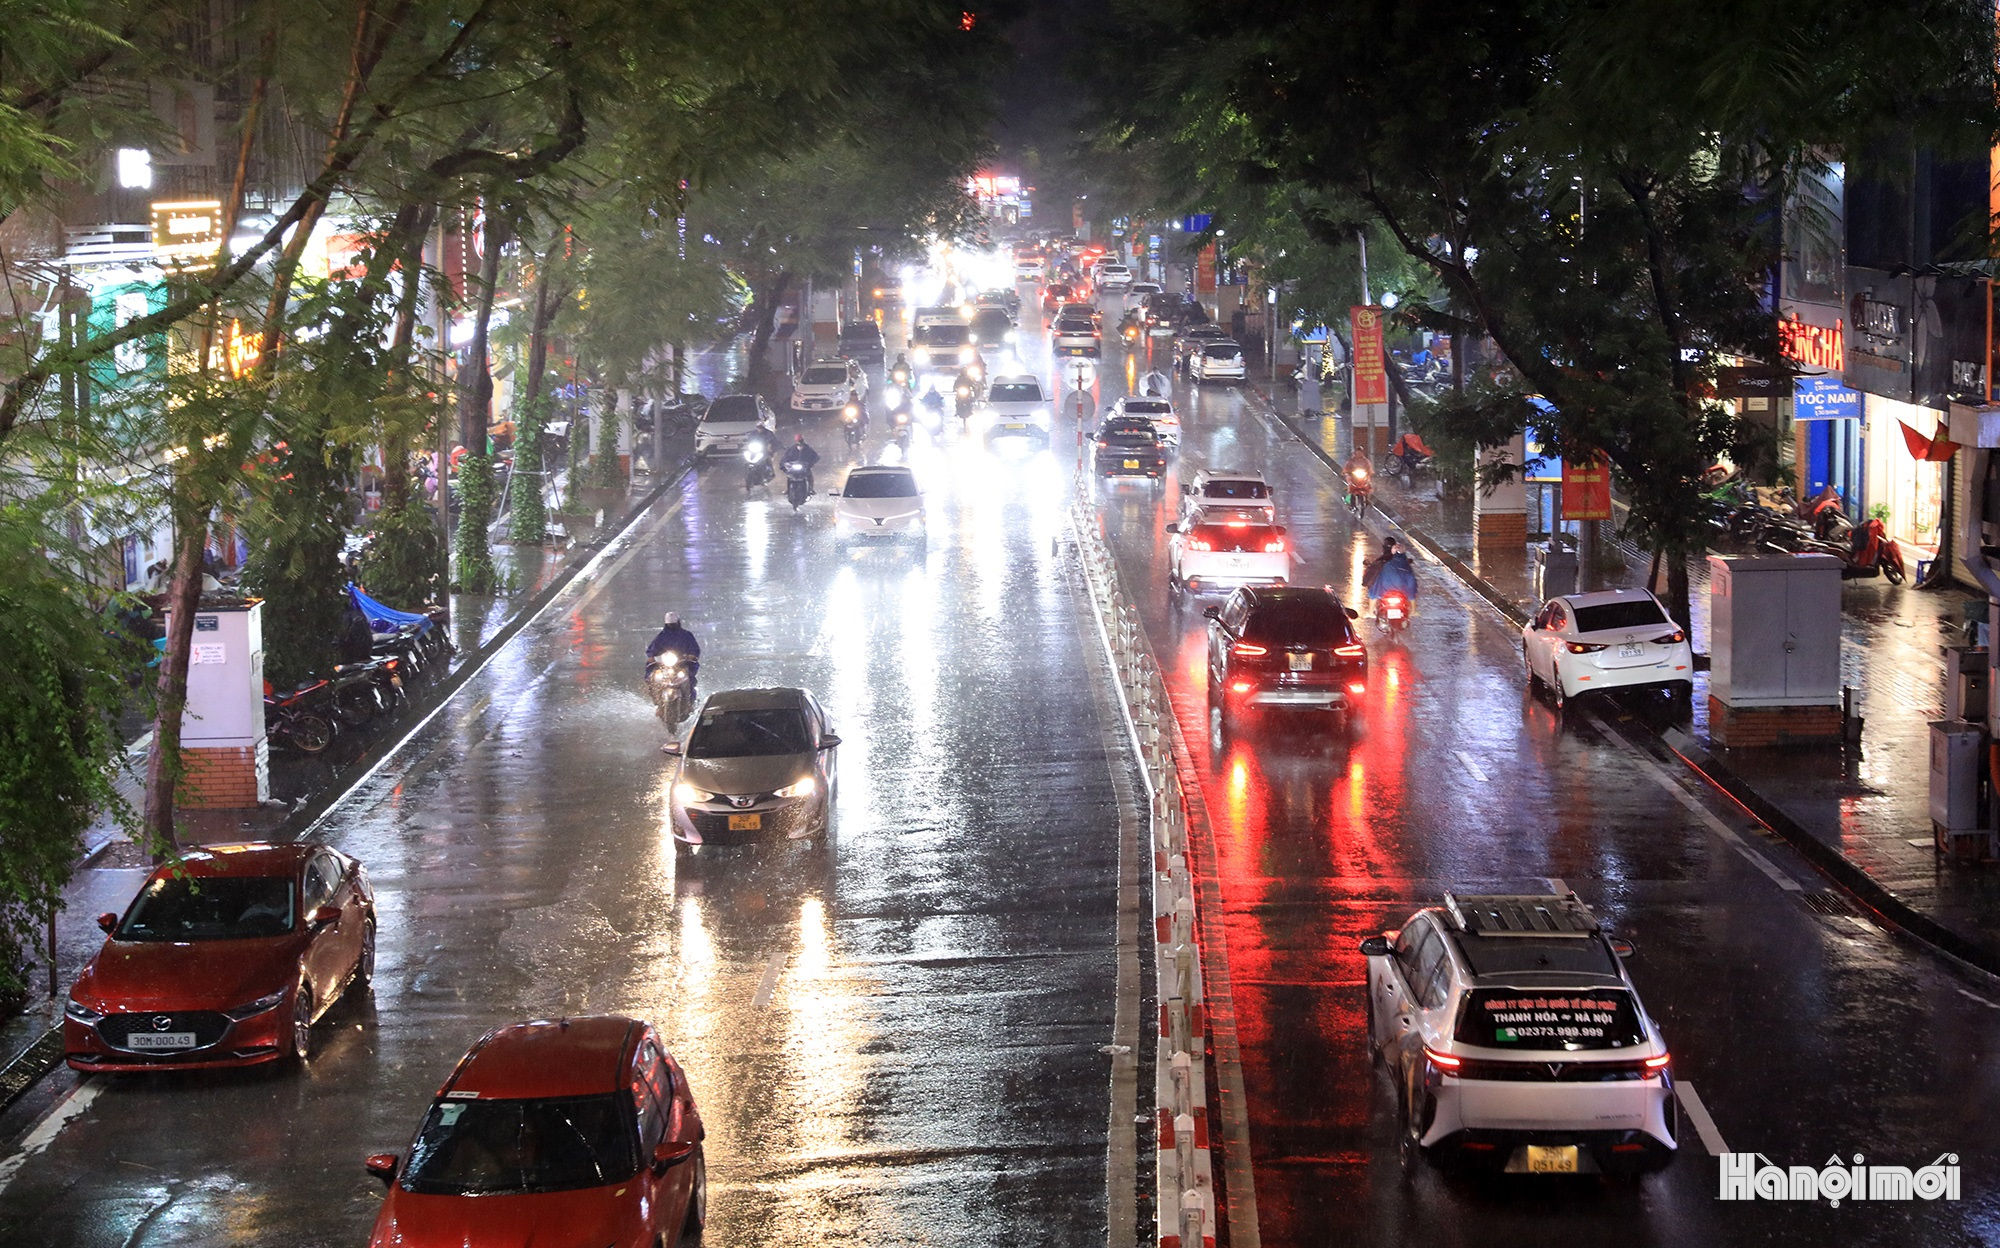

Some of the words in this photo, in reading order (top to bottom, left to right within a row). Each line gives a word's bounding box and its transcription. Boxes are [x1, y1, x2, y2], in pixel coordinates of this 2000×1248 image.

[1798, 391, 1825, 405] TÓC
[1827, 393, 1857, 404] NAM
[1493, 1012, 1532, 1023] THANH
[1534, 1010, 1559, 1022] HÓA
[1575, 1011, 1591, 1022] HÀ
[1593, 1011, 1613, 1025] NỘI
